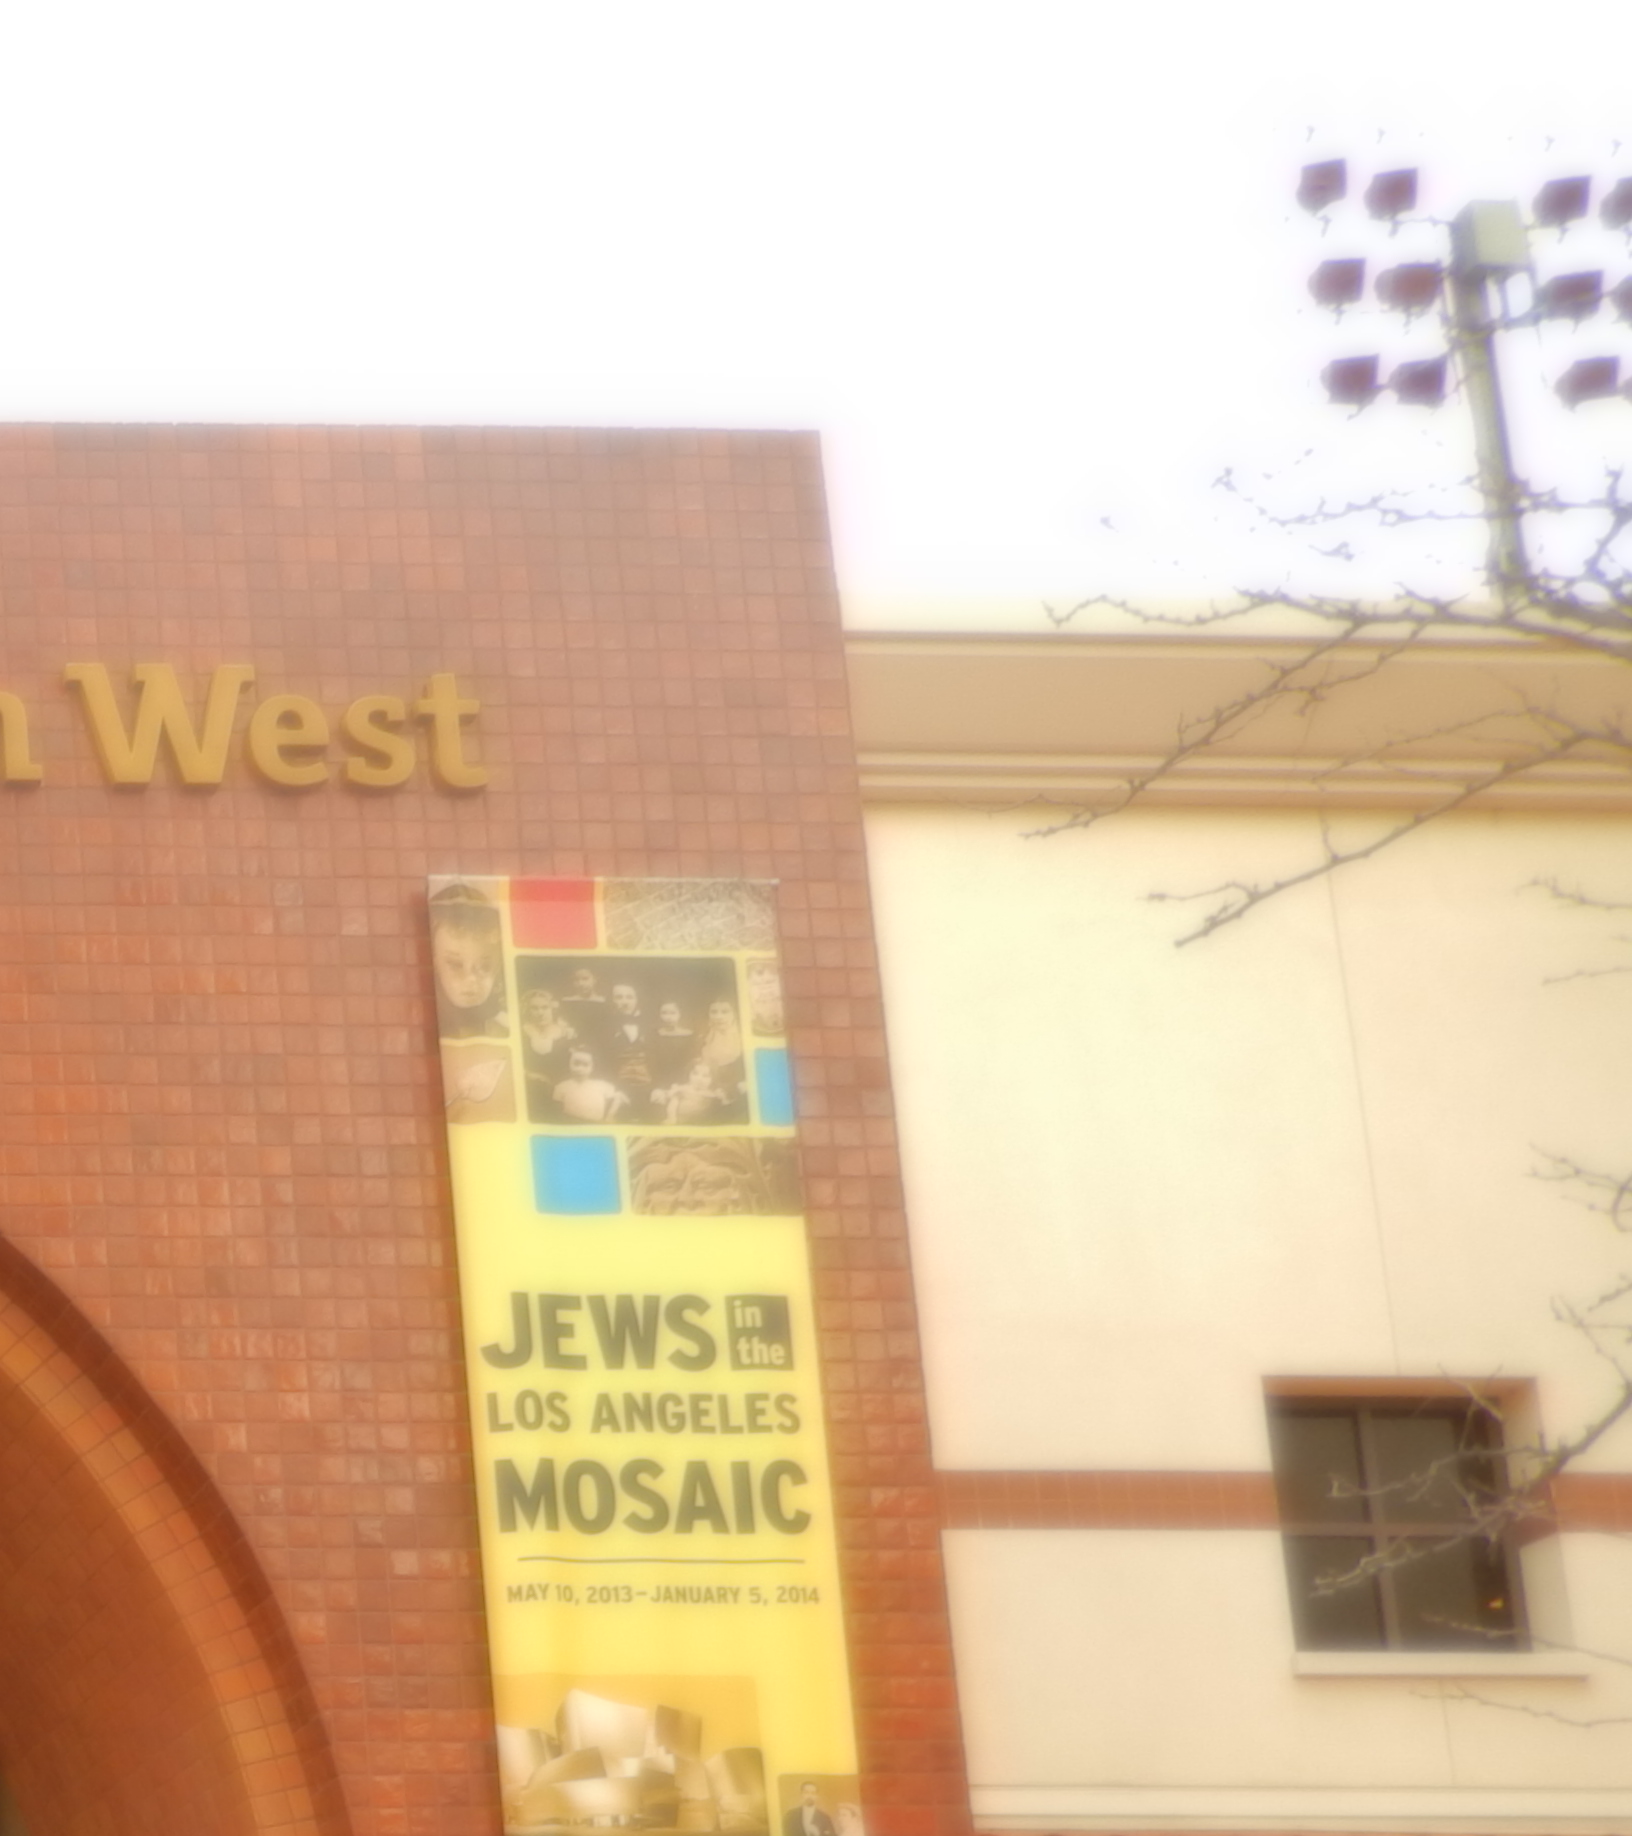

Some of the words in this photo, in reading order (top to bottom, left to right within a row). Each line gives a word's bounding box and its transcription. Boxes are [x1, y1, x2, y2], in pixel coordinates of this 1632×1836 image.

[65, 661, 490, 790] West
[480, 1291, 718, 1372] JEWS
[732, 1300, 763, 1329] in
[736, 1336, 786, 1366] the
[486, 1389, 572, 1434] LOS
[589, 1391, 802, 1435] ANGELES
[493, 1457, 812, 1536] MOSAIC
[506, 1584, 550, 1603] MAY
[555, 1584, 580, 1606] 10,
[748, 1586, 769, 1606] 5,
[776, 1586, 820, 1605] 2014
